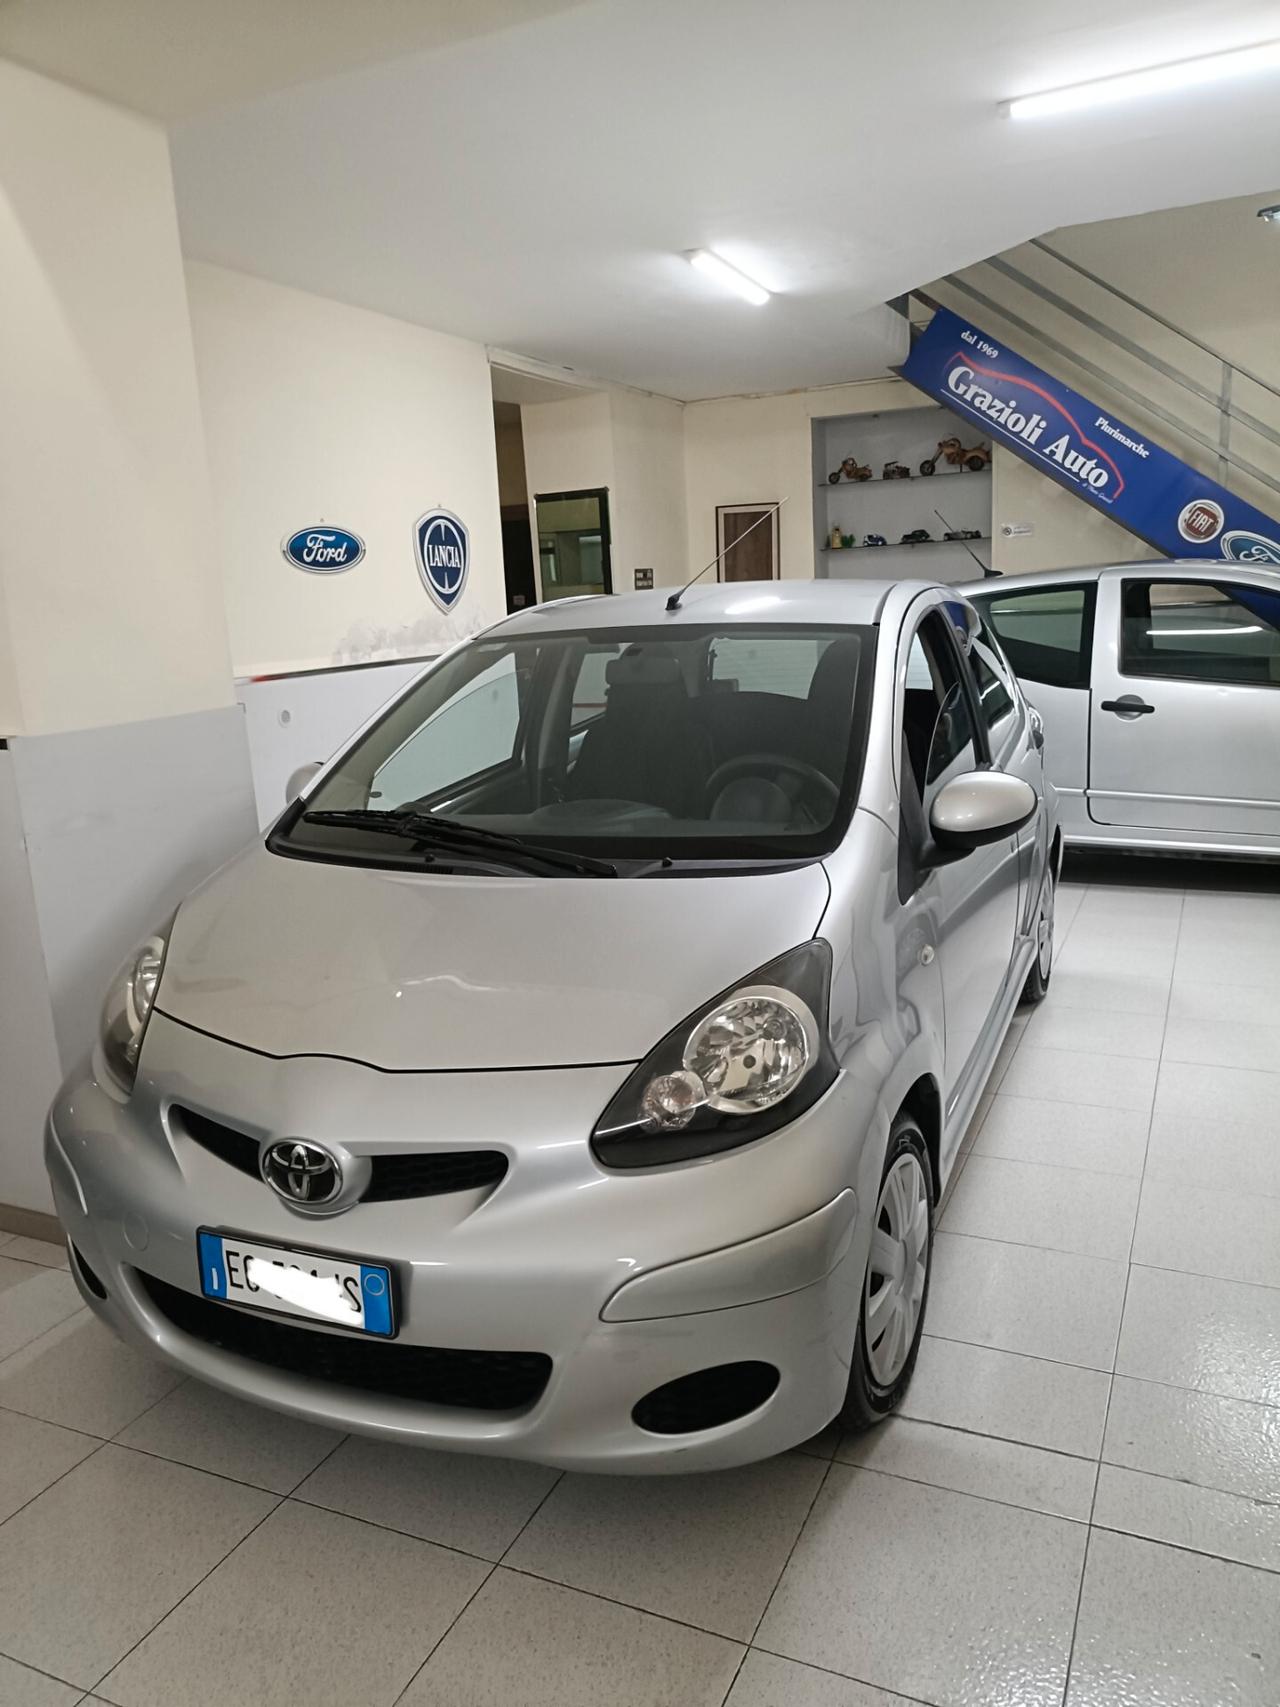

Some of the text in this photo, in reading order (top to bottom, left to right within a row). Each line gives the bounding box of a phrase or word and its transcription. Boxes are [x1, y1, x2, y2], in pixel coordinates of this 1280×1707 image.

[961, 331, 999, 360] dal 1969
[948, 366, 1108, 488] Grazioli Auto
[1095, 416, 1150, 458] Plurimarche
[1188, 510, 1214, 533] FIAT
[303, 534, 347, 563] Ford
[428, 544, 461, 568] LANCIA
